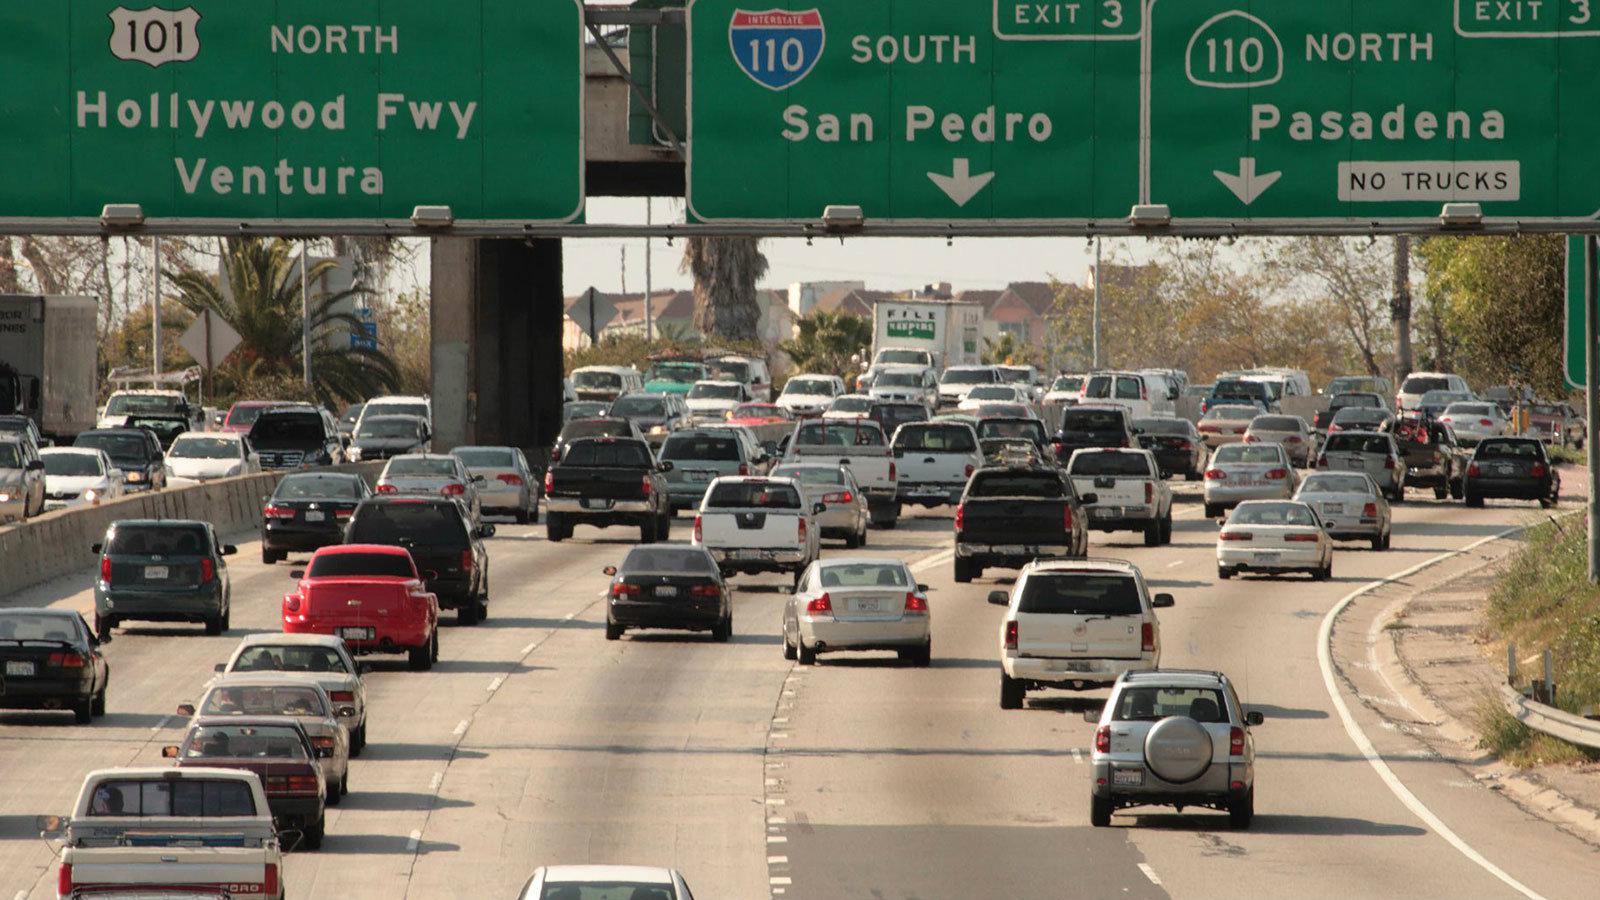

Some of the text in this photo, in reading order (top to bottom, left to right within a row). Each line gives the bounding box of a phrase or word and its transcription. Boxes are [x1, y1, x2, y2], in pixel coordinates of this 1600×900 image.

[748, 15, 804, 24] INTERSTATE
[1015, 0, 1123, 28] EXIT 3
[1475, 0, 1591, 24] EXIT 3
[127, 19, 183, 54] 101
[271, 25, 398, 53] NORTH
[851, 35, 976, 64] SOUTH
[1305, 33, 1433, 61] NORTH
[750, 37, 804, 72] 110
[1206, 37, 1264, 73] 110
[77, 90, 477, 139] Hollywood Fwy
[782, 104, 1052, 142] San Pedro
[1251, 103, 1505, 141] Pasadena
[174, 157, 384, 195] Ventura
[1350, 172, 1508, 191] NO TRUCKS
[887, 310, 936, 320] FILE
